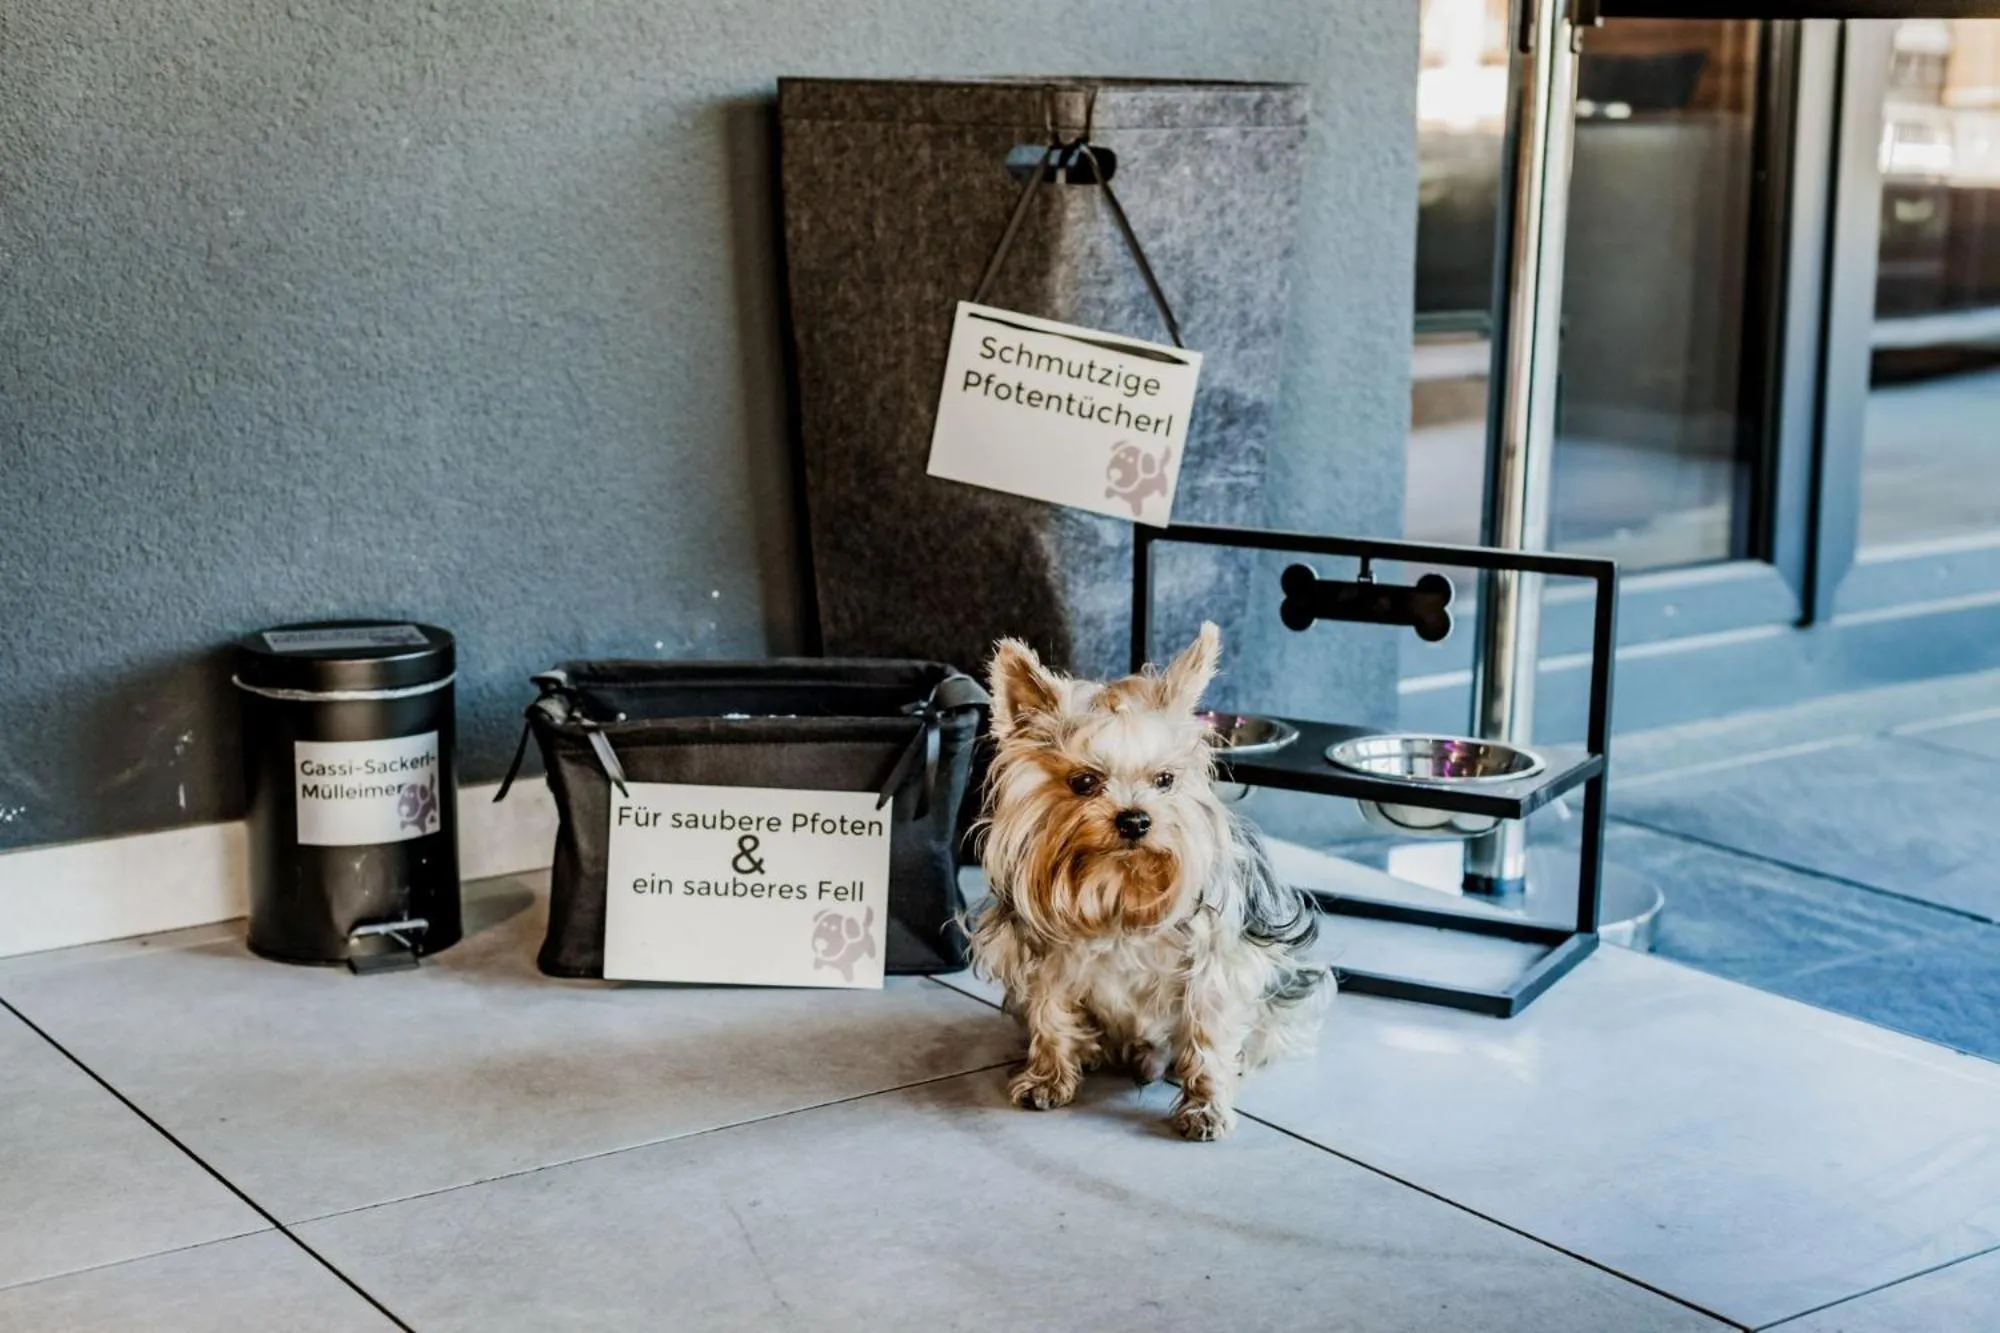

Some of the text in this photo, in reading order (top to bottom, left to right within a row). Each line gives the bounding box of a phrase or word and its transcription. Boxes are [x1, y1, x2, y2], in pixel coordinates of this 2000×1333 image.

[980, 336, 1161, 397] Schmutzige
[962, 370, 1173, 437] Pfotentücherl
[301, 752, 436, 777] Gassi-Sackerl-
[302, 782, 404, 800] Mülleimer
[617, 806, 883, 836] Für saubere Pfoten
[732, 834, 765, 875] &
[632, 873, 864, 902] ein sauberes Fell
